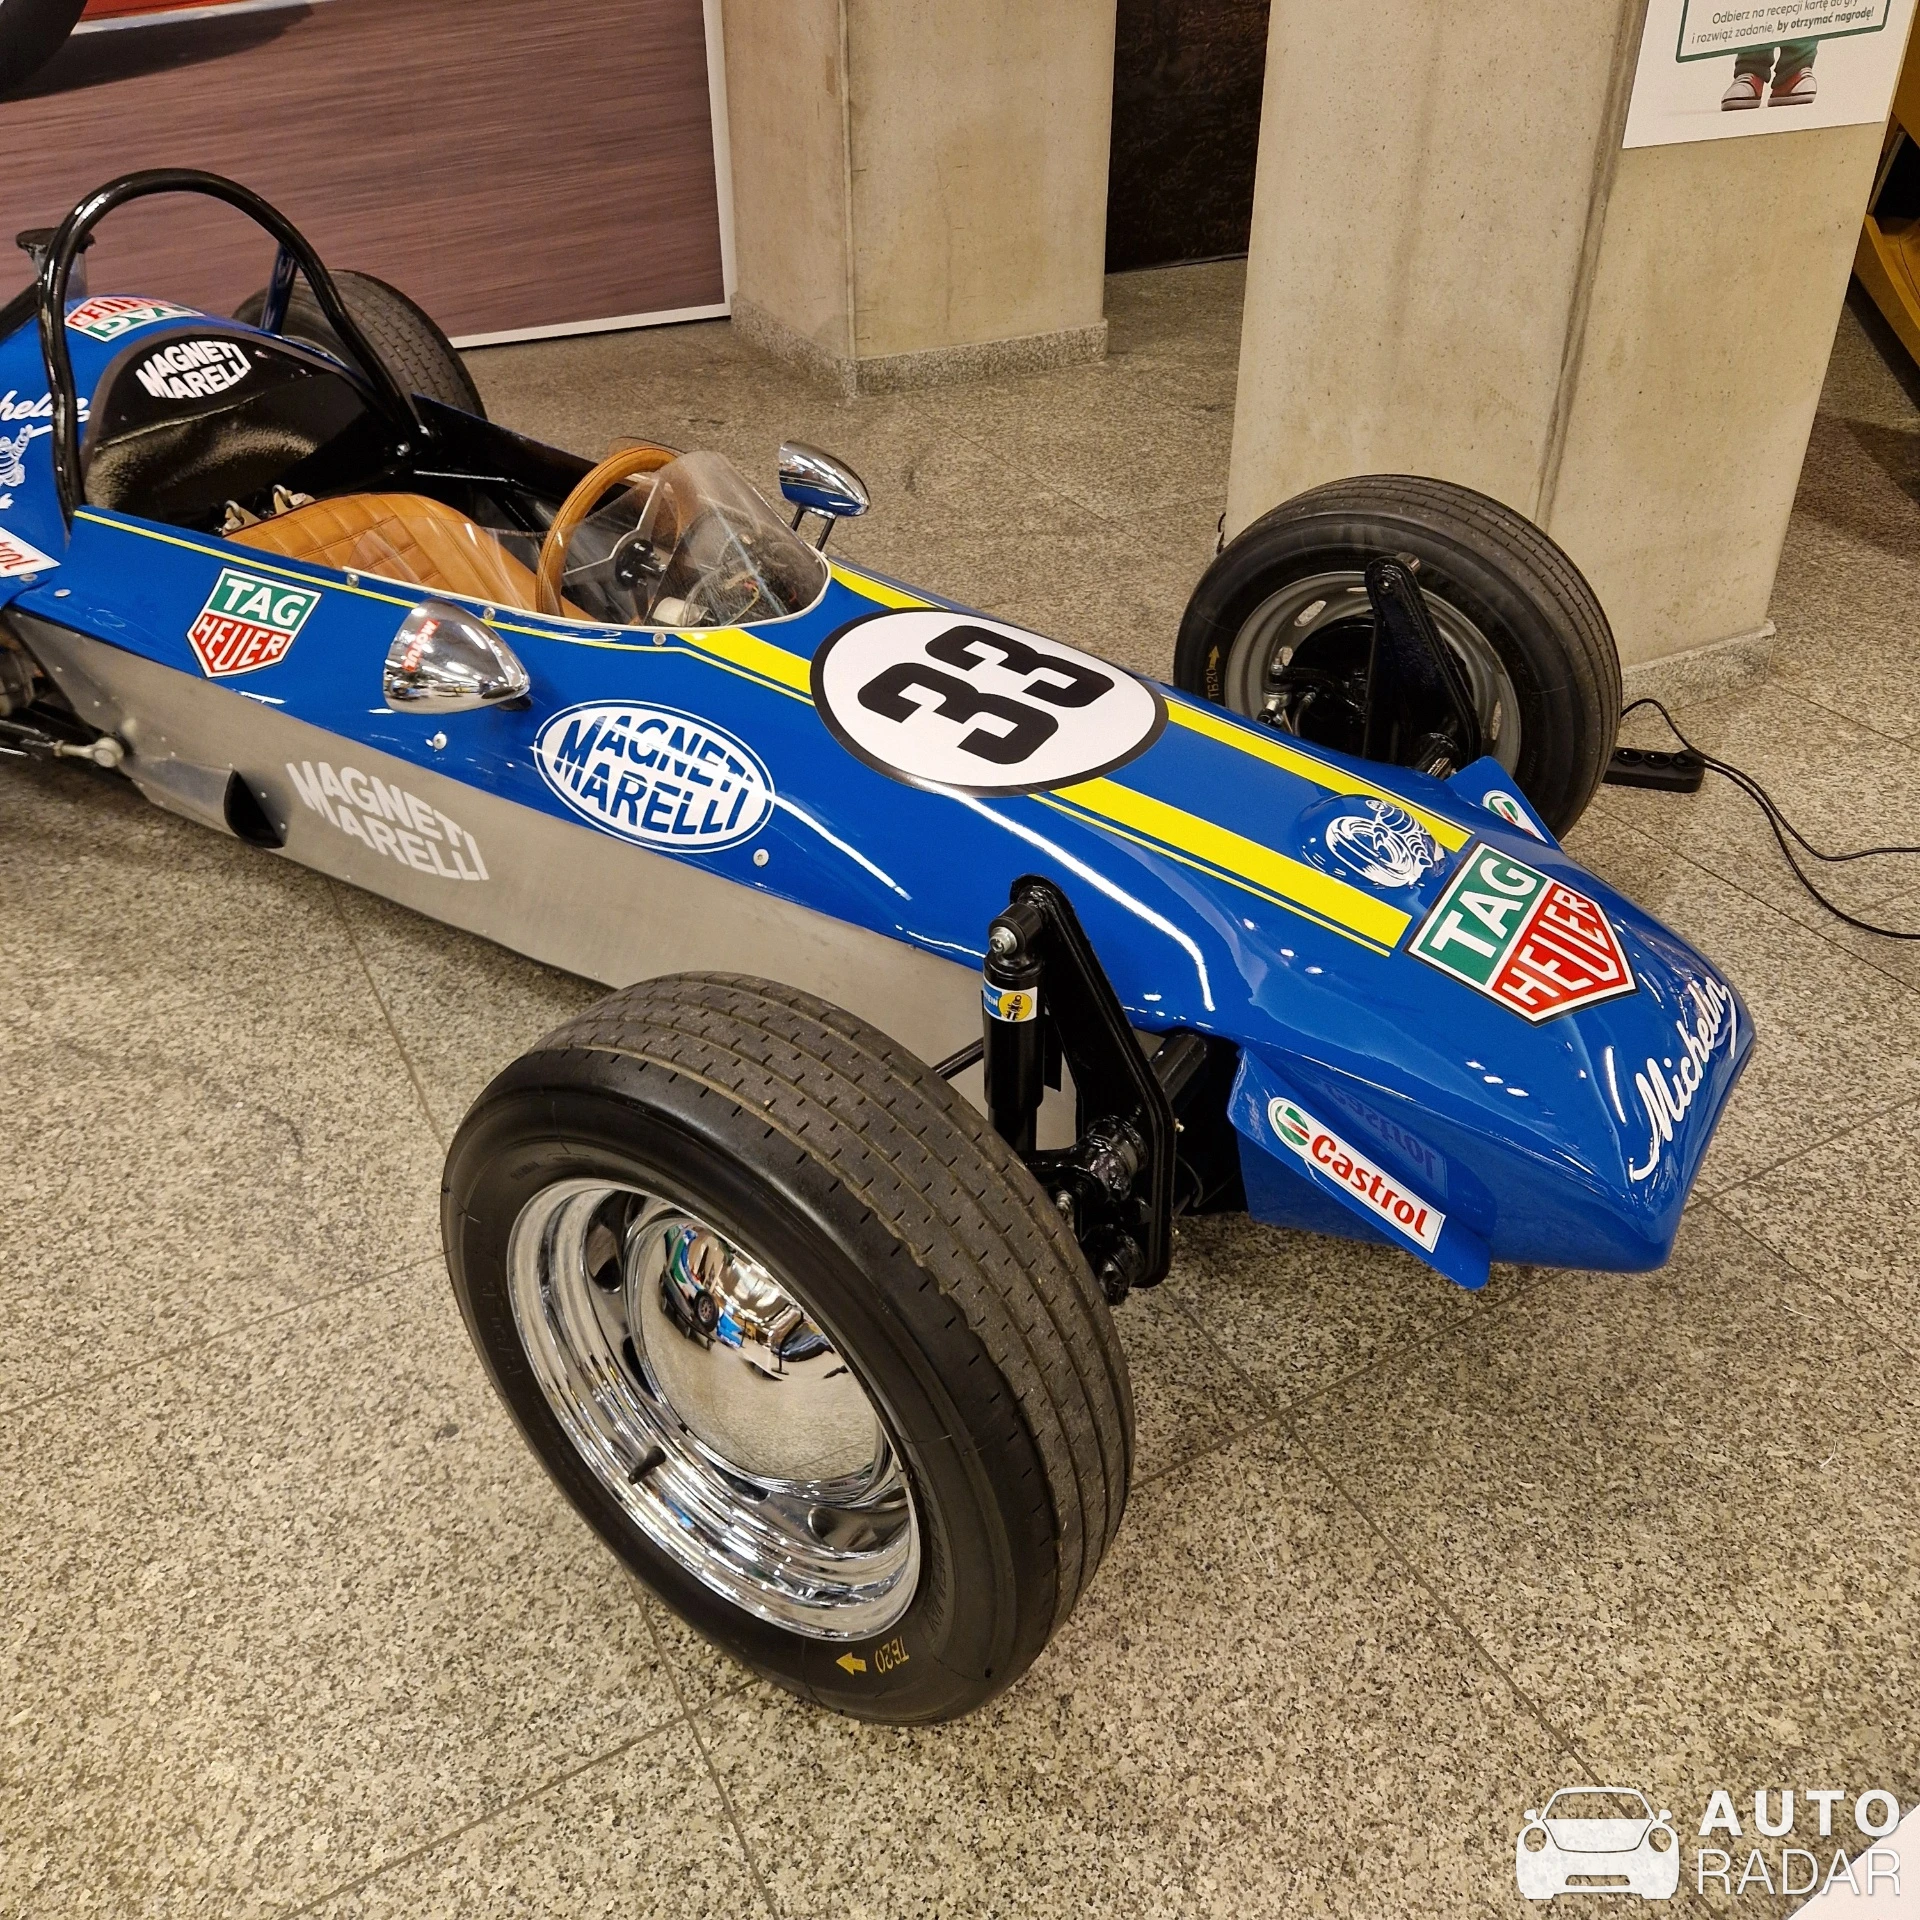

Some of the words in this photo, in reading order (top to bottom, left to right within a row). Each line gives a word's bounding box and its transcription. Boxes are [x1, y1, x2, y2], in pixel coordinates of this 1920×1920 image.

[1697, 27, 1733, 42] rozwiąż
[1735, 22, 1775, 38] zadanie,
[1777, 20, 1790, 33] by
[1790, 12, 1834, 29] otrzymać
[1835, 6, 1875, 24] nagrodę!
[1712, 9, 1751, 24] Odbierz
[1752, 8, 1764, 18] na
[1766, 1, 1803, 16] recepcji
[136, 341, 251, 378] MAGNETI
[143, 360, 251, 399] MARELLI
[223, 577, 307, 627] TAG
[195, 615, 288, 672] HEUER
[403, 620, 438, 668] MOTUL
[857, 625, 1115, 765] 33
[553, 715, 754, 793] MAGNETI
[553, 752, 750, 836] MARELLI
[286, 761, 485, 850] MAGNETI
[299, 788, 490, 882] MARELLI
[1429, 857, 1537, 959] TAG
[1501, 888, 1620, 1006] HEUER
[1631, 976, 1736, 1181] Michelin
[1311, 1134, 1428, 1239] Castrol
